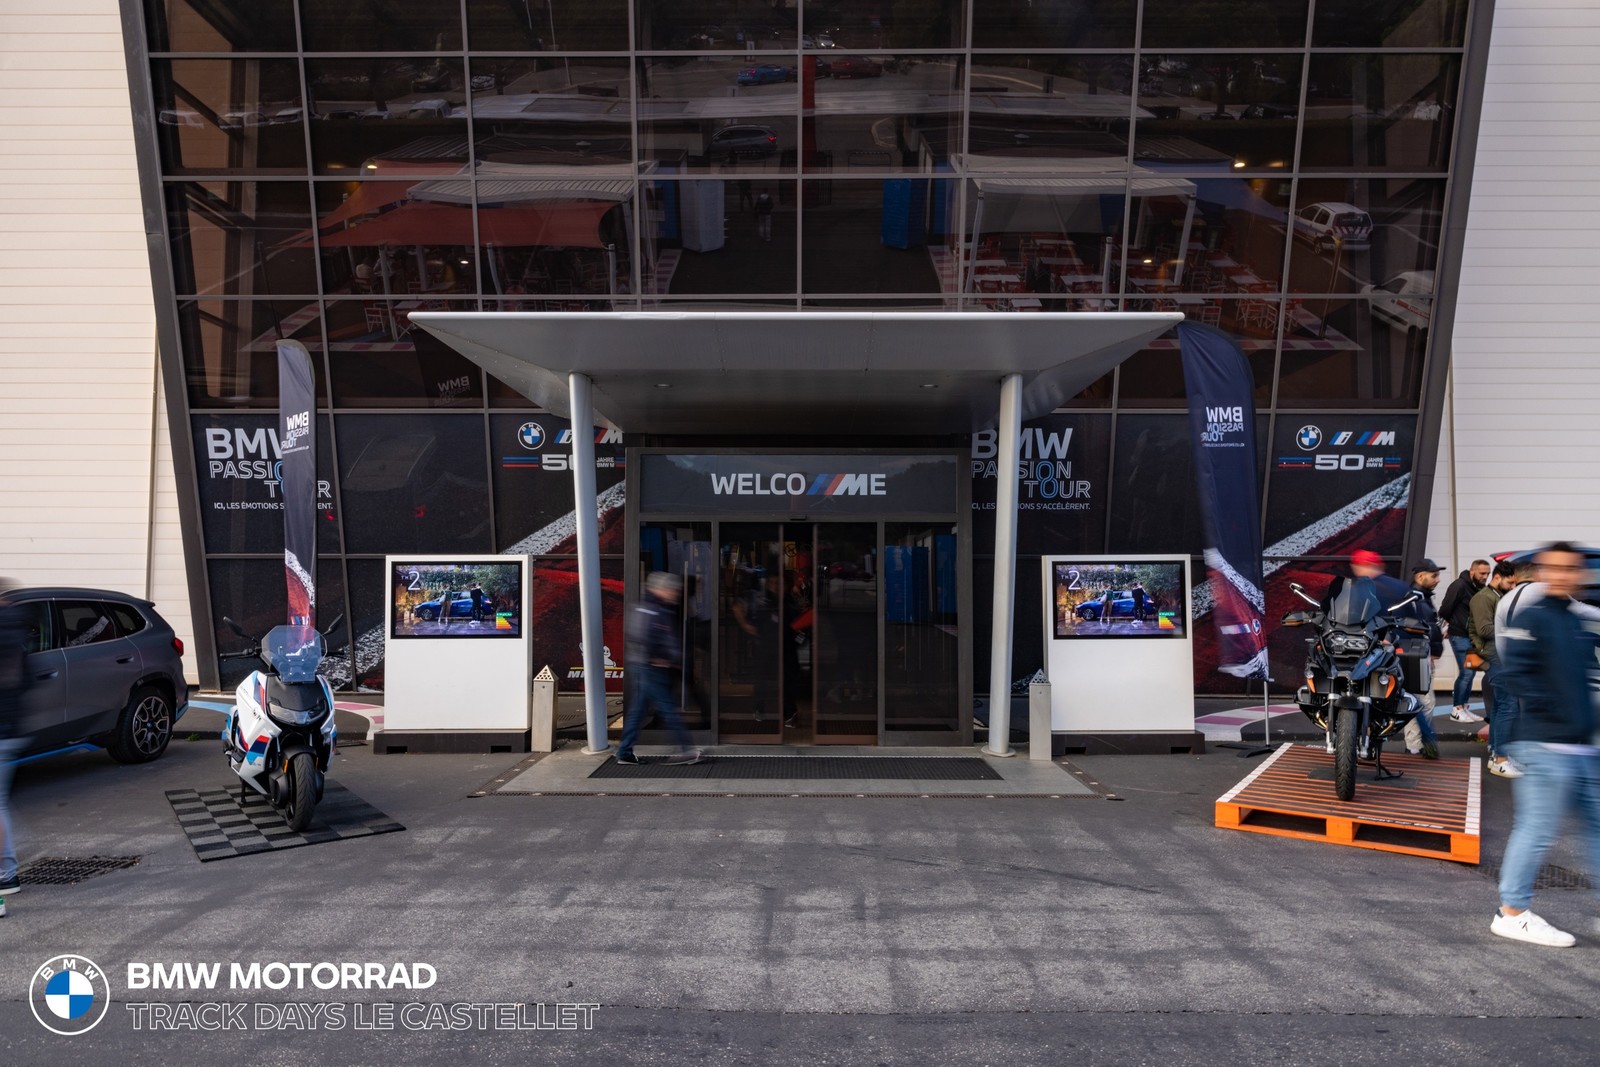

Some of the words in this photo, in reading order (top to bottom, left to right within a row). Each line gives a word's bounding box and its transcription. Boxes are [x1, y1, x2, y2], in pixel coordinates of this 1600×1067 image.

[541, 454, 575, 471] 5
[971, 461, 1072, 481] PASION
[1314, 454, 1365, 471] 50
[264, 480, 332, 498] TR
[1023, 478, 1091, 499] TOUR
[213, 502, 226, 510] ICI,
[241, 500, 279, 510] ÉMOTIONS
[981, 502, 996, 510] LES
[1036, 500, 1091, 510] S'ACCÉLÈRENT.
[408, 570, 420, 590] 2
[1068, 570, 1081, 590] 2
